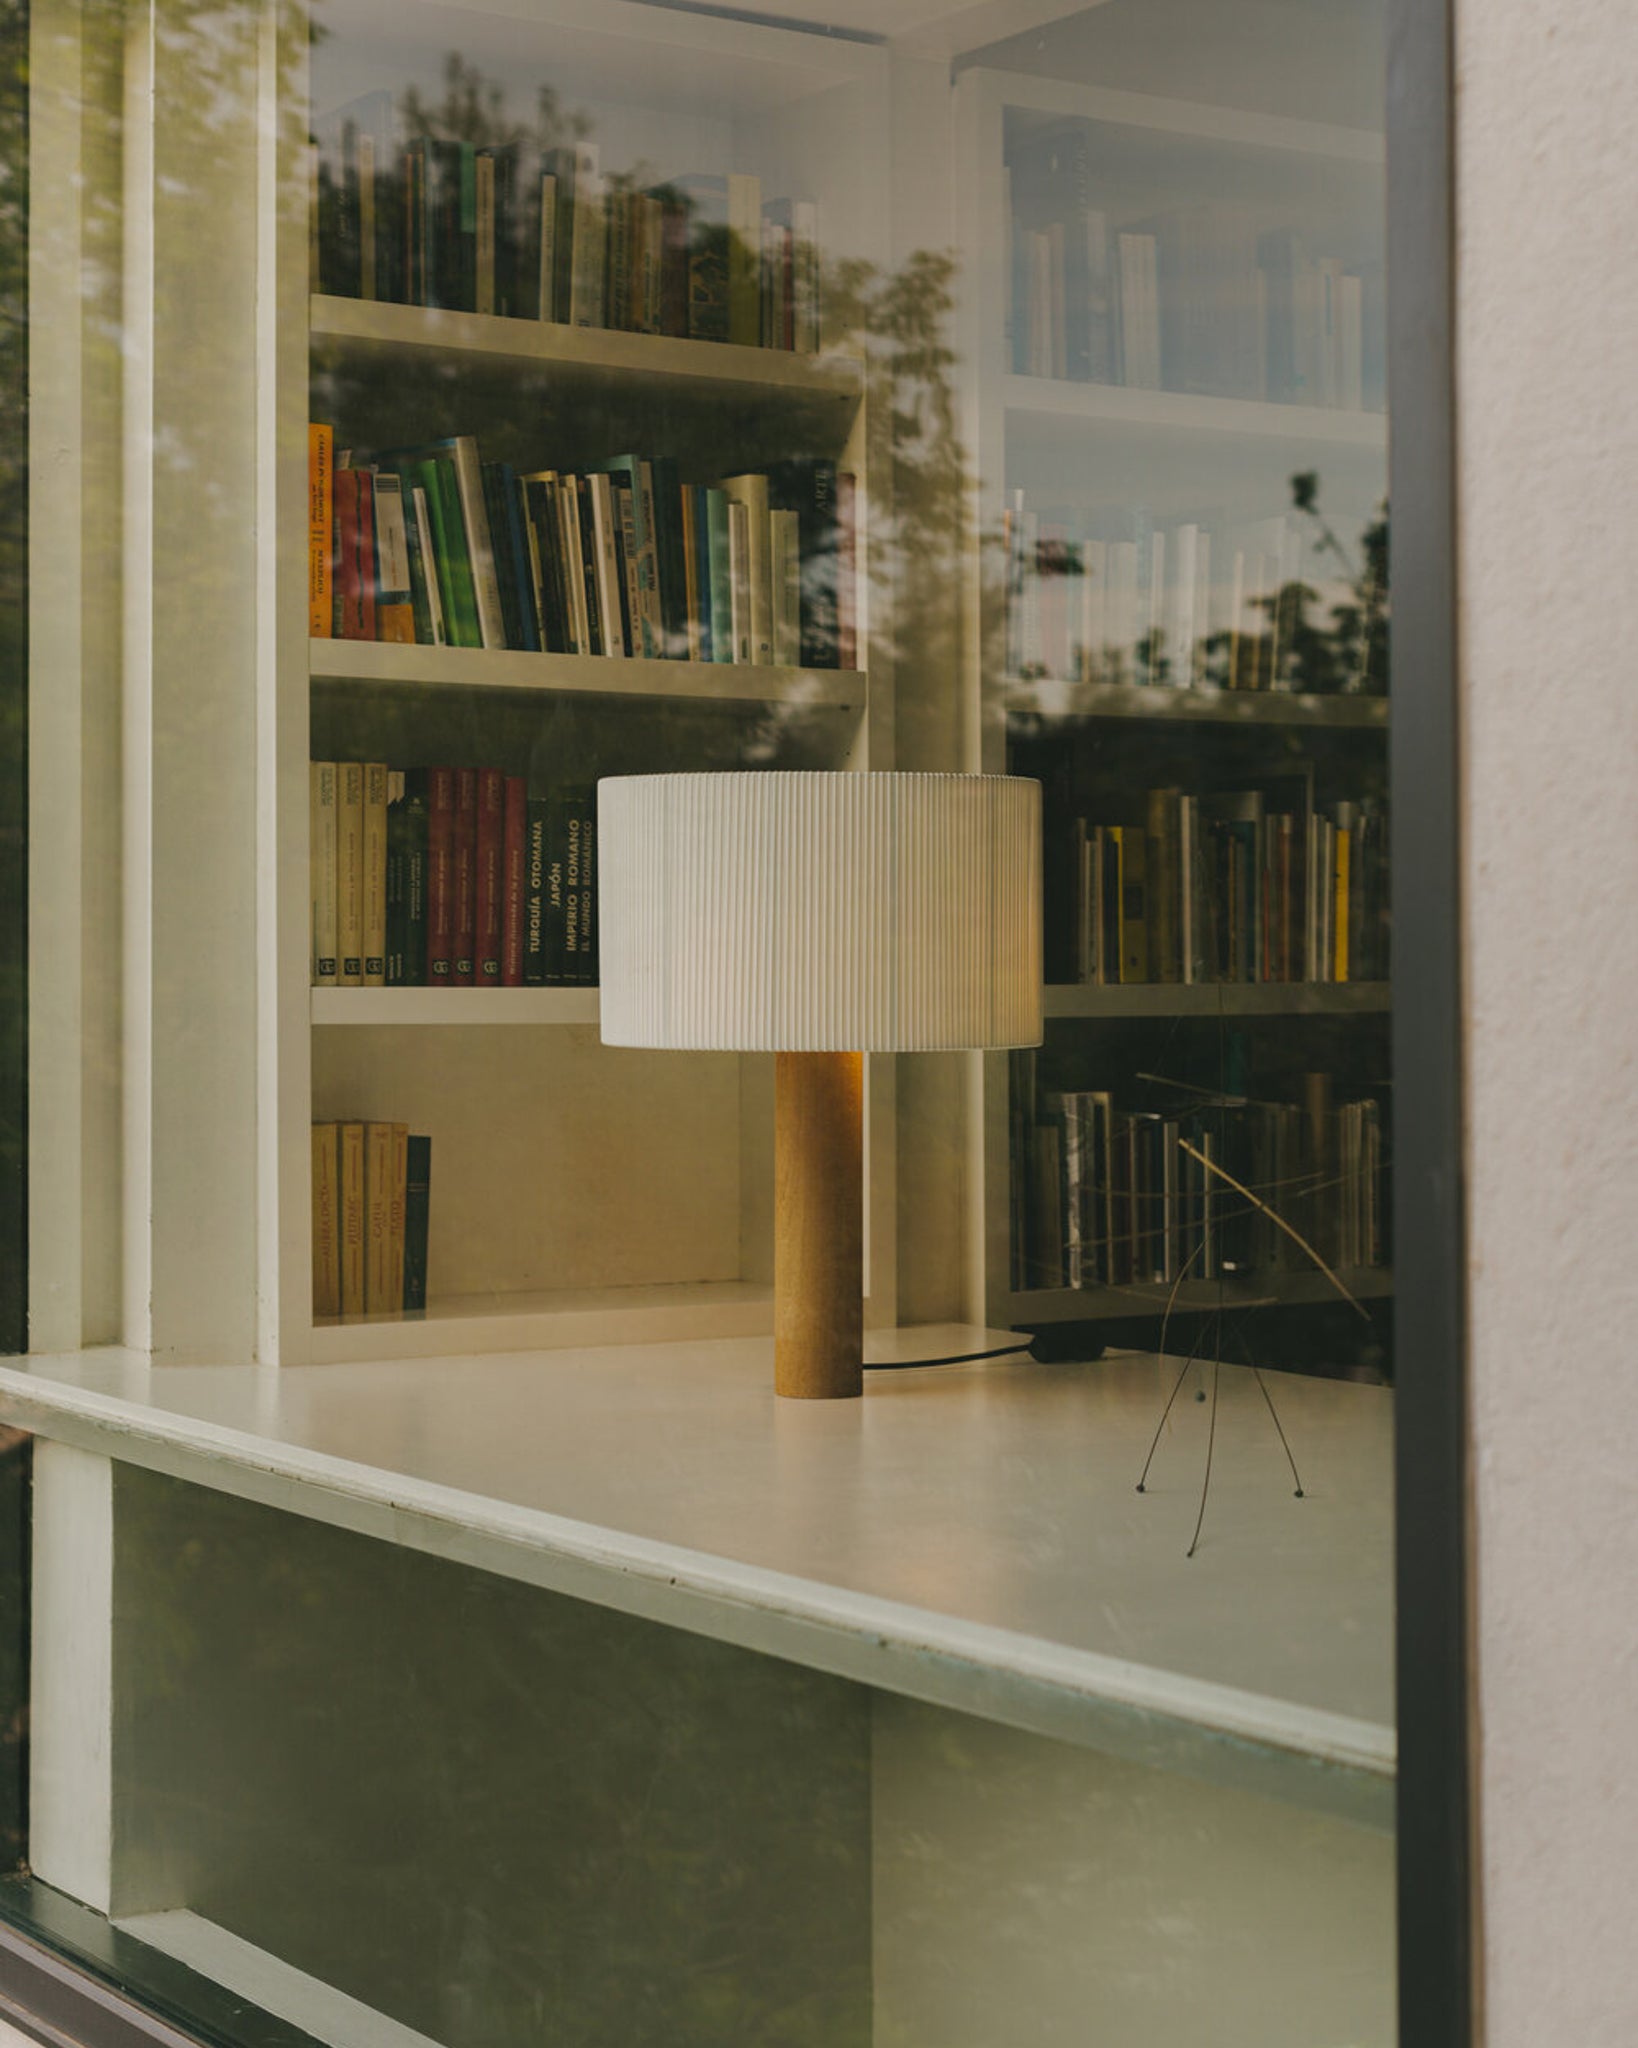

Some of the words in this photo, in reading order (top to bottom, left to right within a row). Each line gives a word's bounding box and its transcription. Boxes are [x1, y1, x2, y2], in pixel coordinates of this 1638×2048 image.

[530, 821, 542, 889] OTOMANA
[568, 819, 580, 886] ROMANO
[548, 862, 561, 908] JAPÓN
[582, 890, 591, 937] MUNDO
[528, 896, 541, 953] TURQUÍA
[566, 894, 578, 952] IMPERIO
[582, 940, 590, 952] EL
